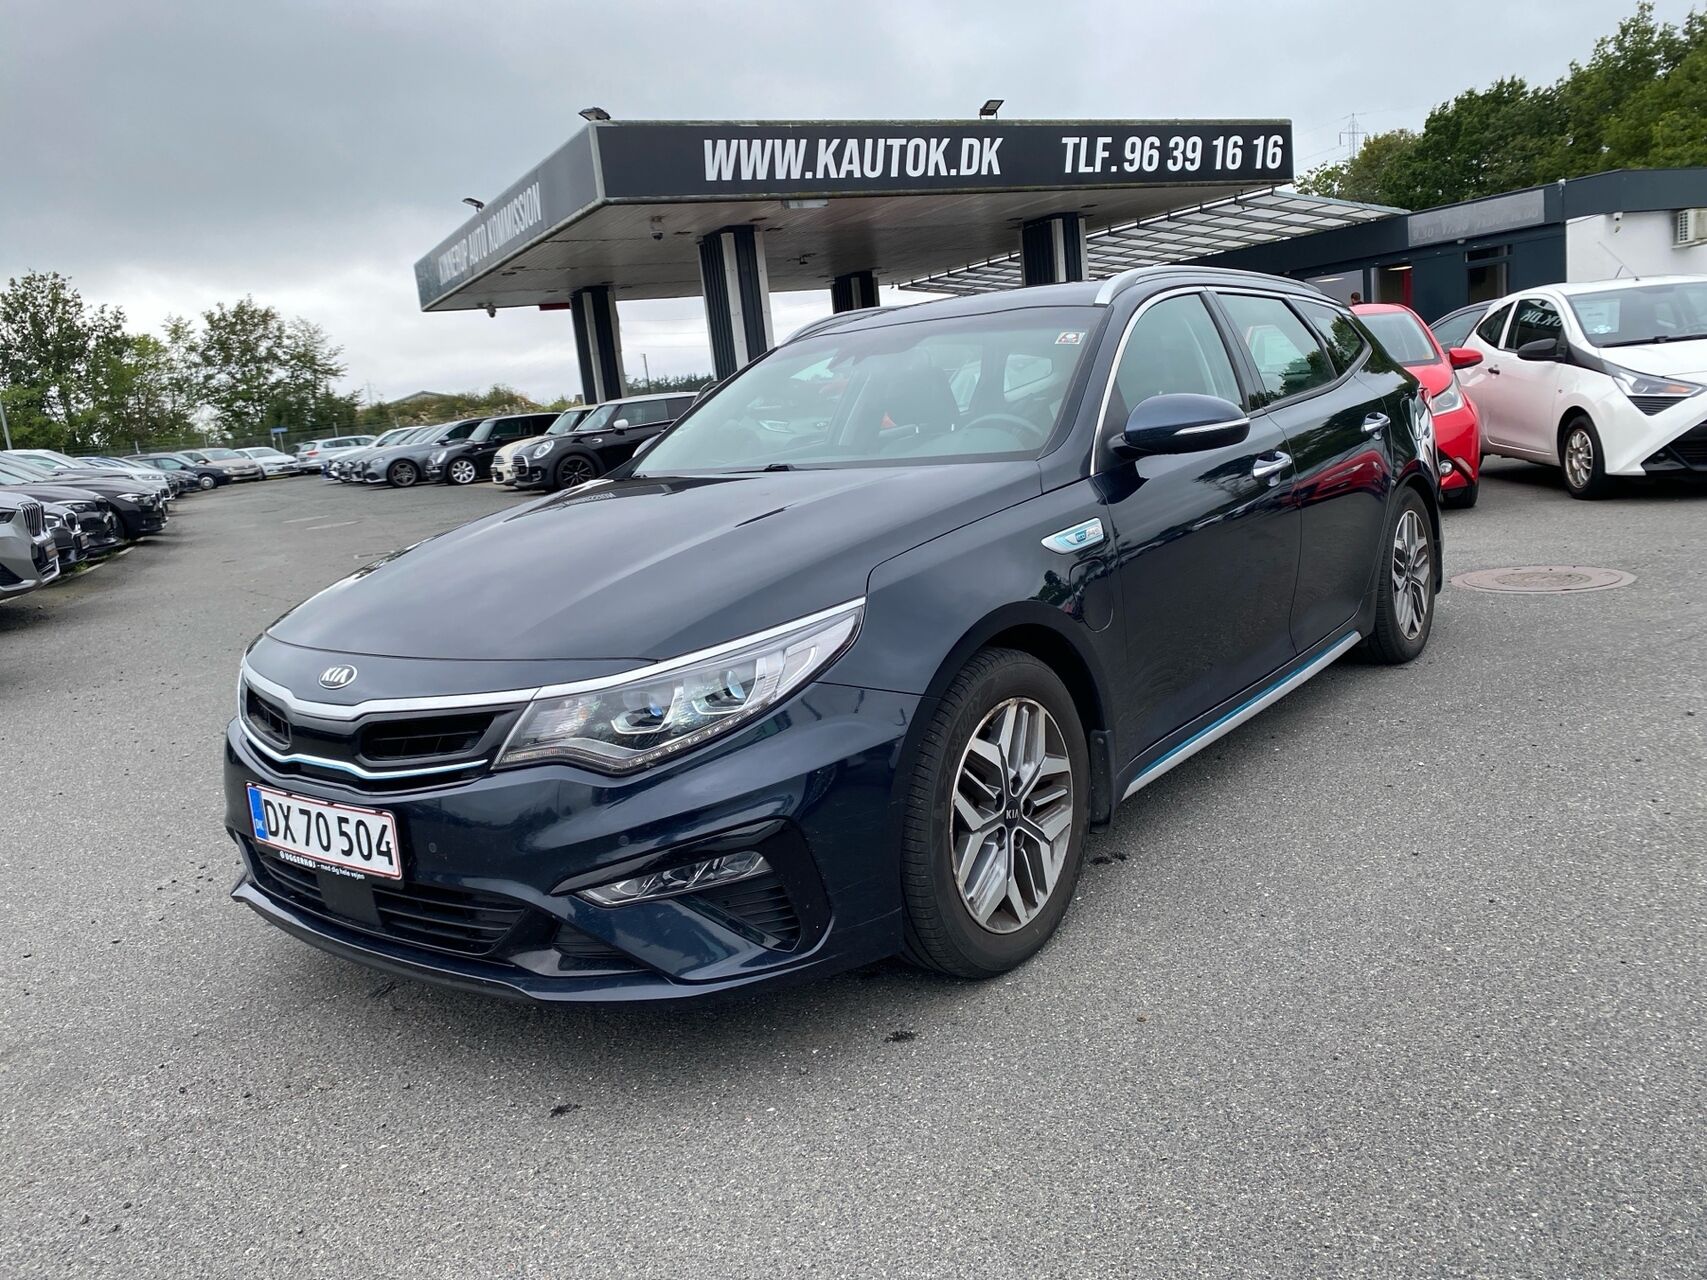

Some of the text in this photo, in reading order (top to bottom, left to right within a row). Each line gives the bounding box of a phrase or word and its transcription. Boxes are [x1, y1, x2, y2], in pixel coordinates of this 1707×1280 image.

[704, 137, 1003, 181] WWW.KAUTOK.DK
[1061, 135, 1284, 173] TLF. 96 39 16 16
[487, 182, 542, 253] KOMMISSION
[321, 666, 350, 684] KIA
[264, 799, 394, 866] DX 70 504
[1006, 808, 1019, 820] KIA
